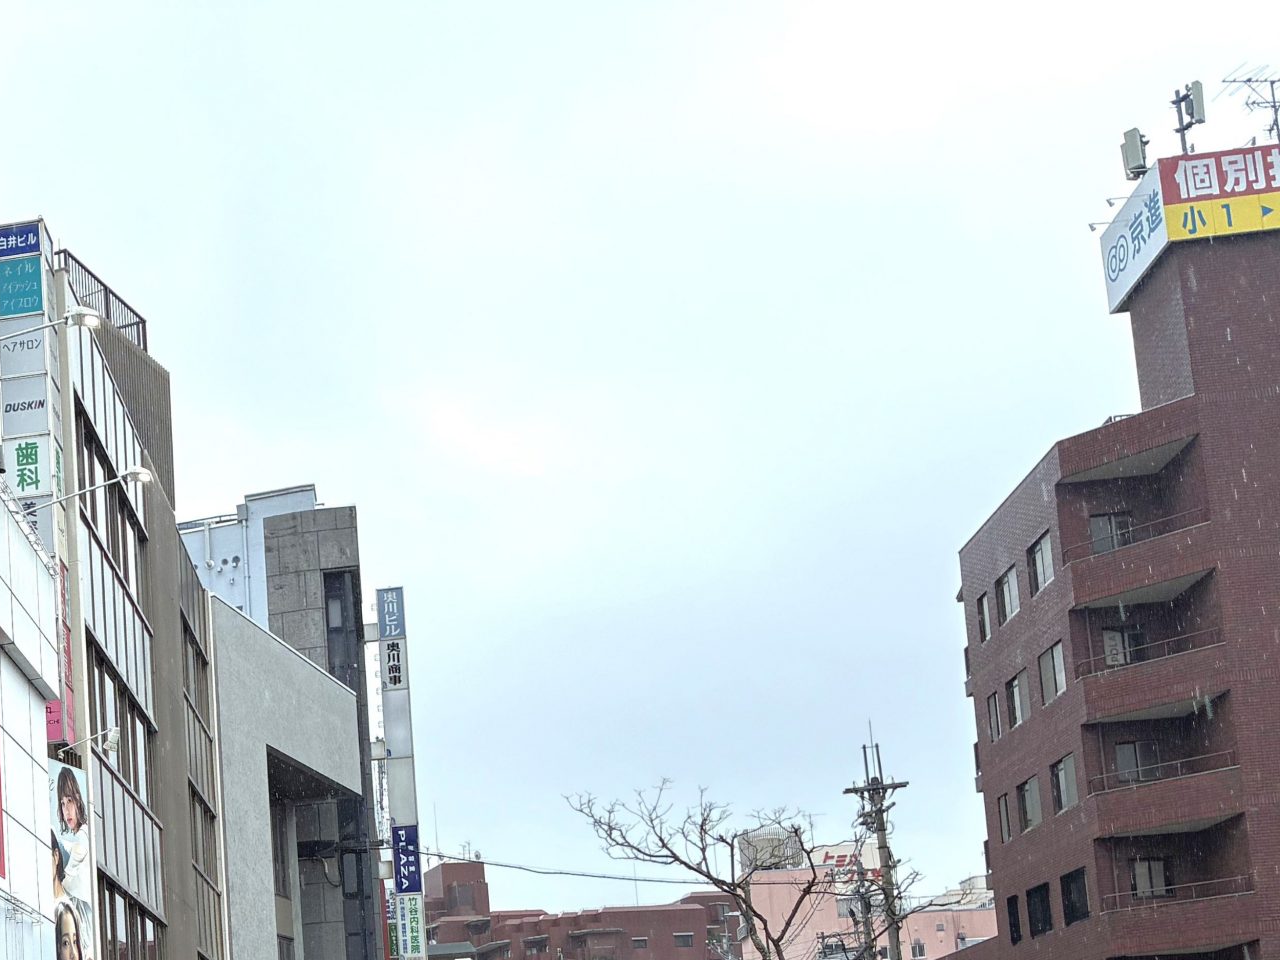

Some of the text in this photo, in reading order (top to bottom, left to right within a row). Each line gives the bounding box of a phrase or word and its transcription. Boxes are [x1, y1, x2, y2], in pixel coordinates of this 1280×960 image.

[2, 338, 42, 353] ヘアサロン
[4, 398, 46, 414] DUSKIN
[15, 441, 41, 492] 歯科
[386, 641, 402, 686] 奥川商事
[398, 830, 410, 890] PLAZA
[408, 896, 421, 954] 竹谷内科医院
